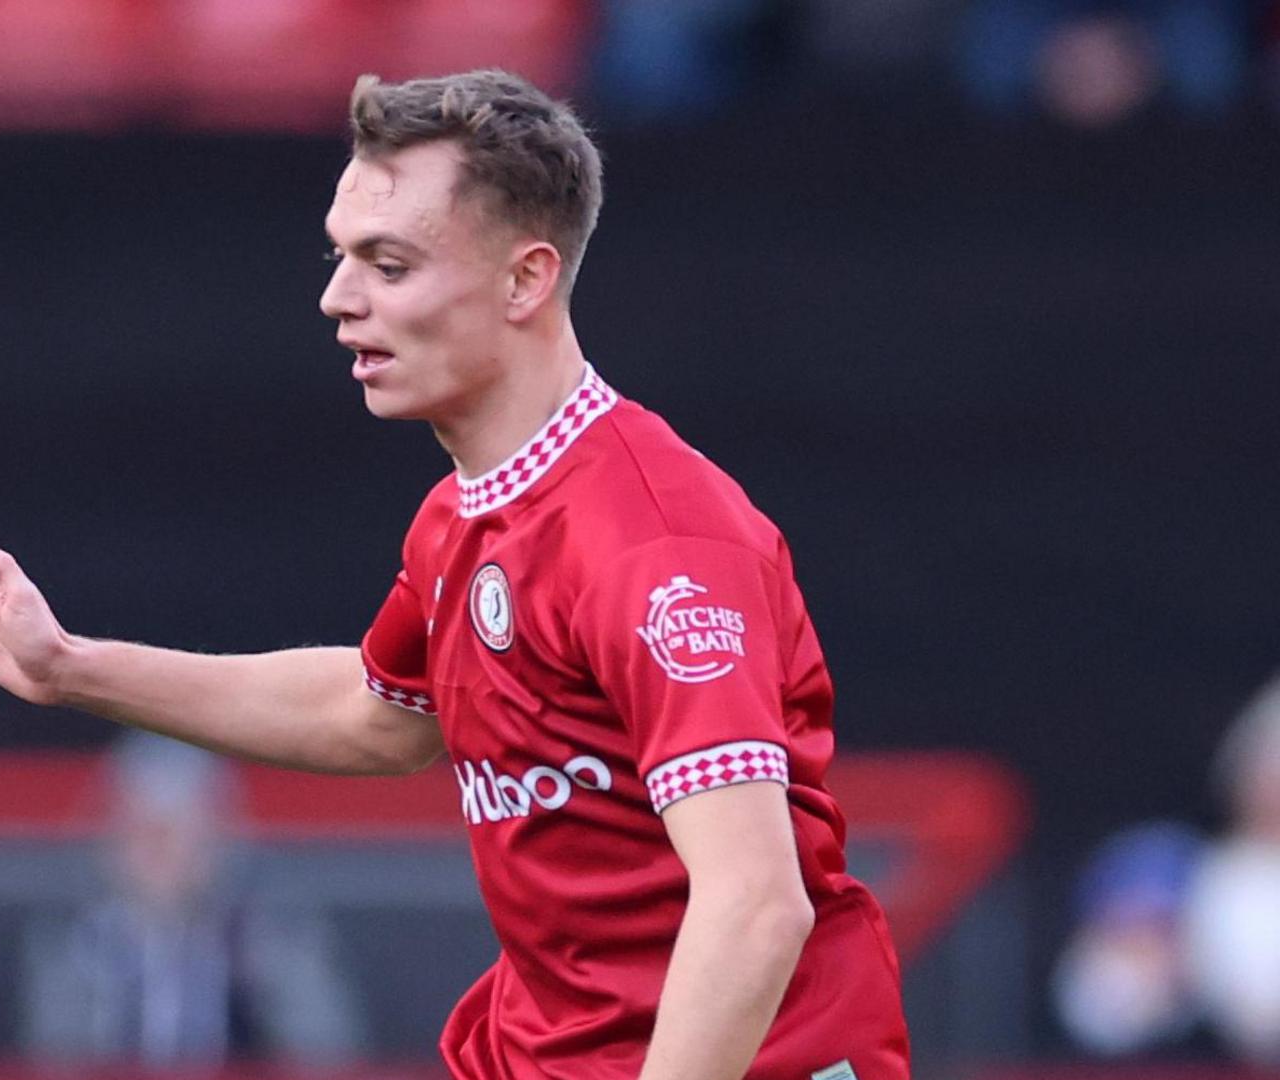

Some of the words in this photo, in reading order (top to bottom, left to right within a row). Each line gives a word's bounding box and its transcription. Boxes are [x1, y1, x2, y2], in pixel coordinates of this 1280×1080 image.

[635, 605, 746, 648] WATCHES
[685, 630, 746, 657] BATH
[453, 755, 612, 826] Huboo
